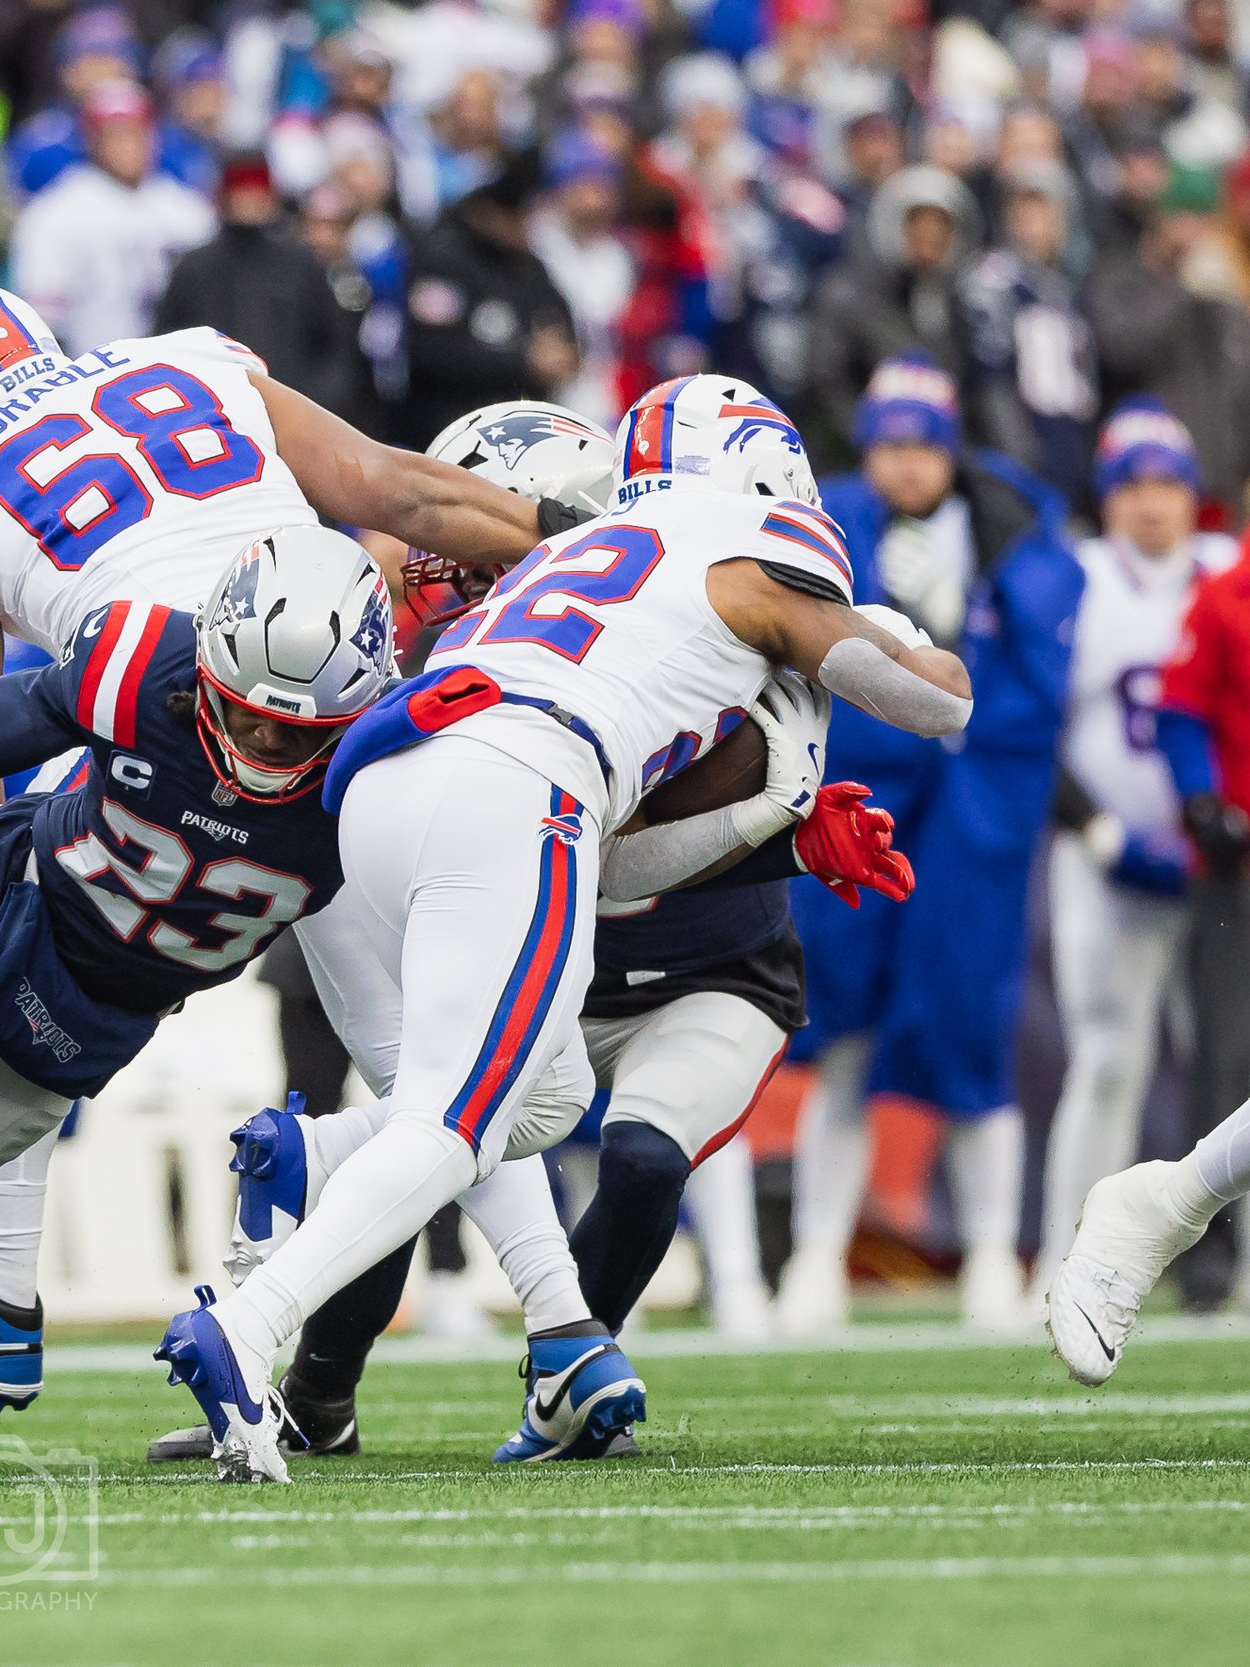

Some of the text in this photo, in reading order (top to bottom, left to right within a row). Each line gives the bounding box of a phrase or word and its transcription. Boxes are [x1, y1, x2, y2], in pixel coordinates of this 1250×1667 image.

[0, 357, 56, 393] BILLS
[617, 479, 673, 505] BILLS
[110, 754, 154, 790] C
[180, 810, 250, 845] PATRIOTS
[53, 796, 314, 972] 23
[13, 975, 82, 1064] PATRIOTS
